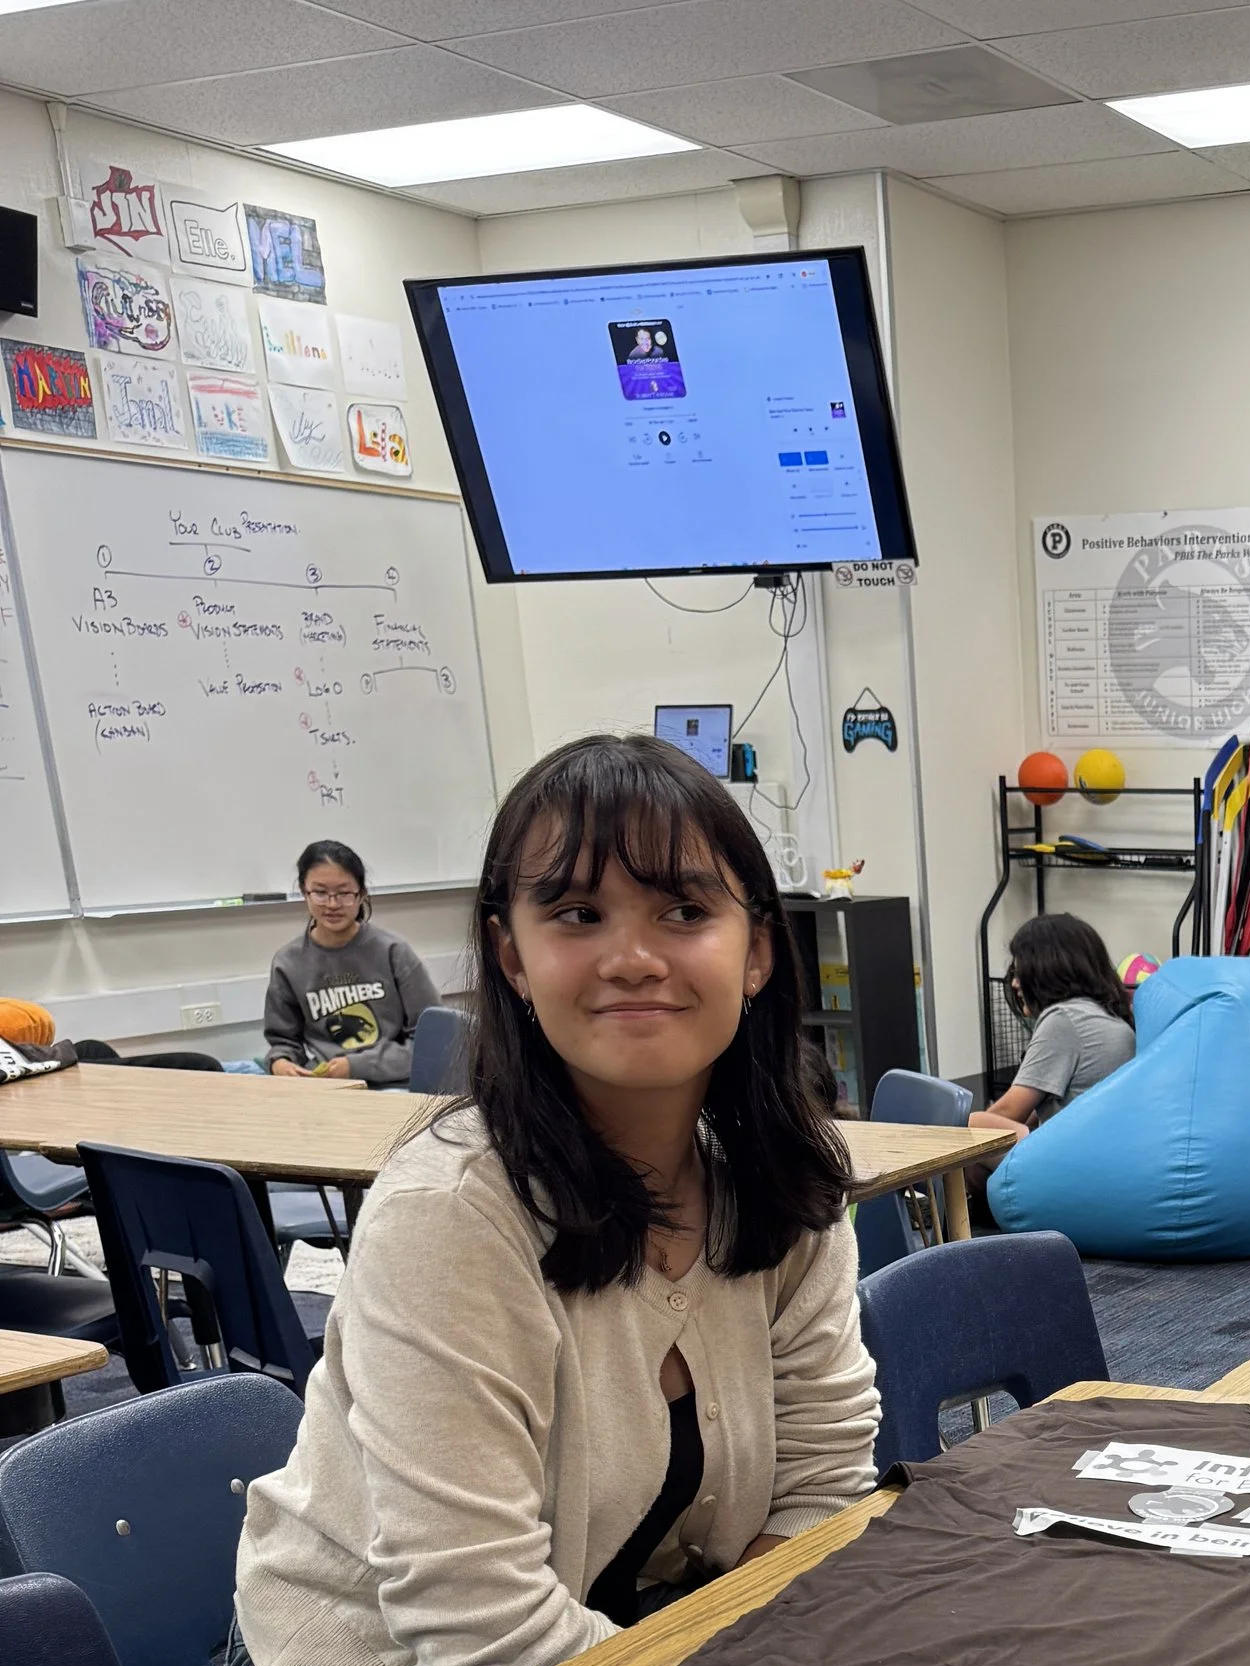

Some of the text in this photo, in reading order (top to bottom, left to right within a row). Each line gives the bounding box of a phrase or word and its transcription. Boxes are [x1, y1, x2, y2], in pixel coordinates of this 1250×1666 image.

[94, 190, 156, 233] JIN
[184, 218, 237, 261] Elle.
[1050, 532, 1063, 550] P
[1082, 537, 1125, 550] Positive
[1127, 534, 1182, 549] Behaviors
[1174, 550, 1195, 561] PBIS
[1197, 549, 1213, 560] The
[1214, 549, 1240, 560] Parks
[853, 561, 894, 572] DO NOT
[857, 577, 895, 587] TOUCH
[844, 721, 893, 747] GAMING
[305, 981, 386, 1021] PANTHERS
[1185, 1472, 1230, 1486] for
[1149, 1530, 1179, 1541] in
